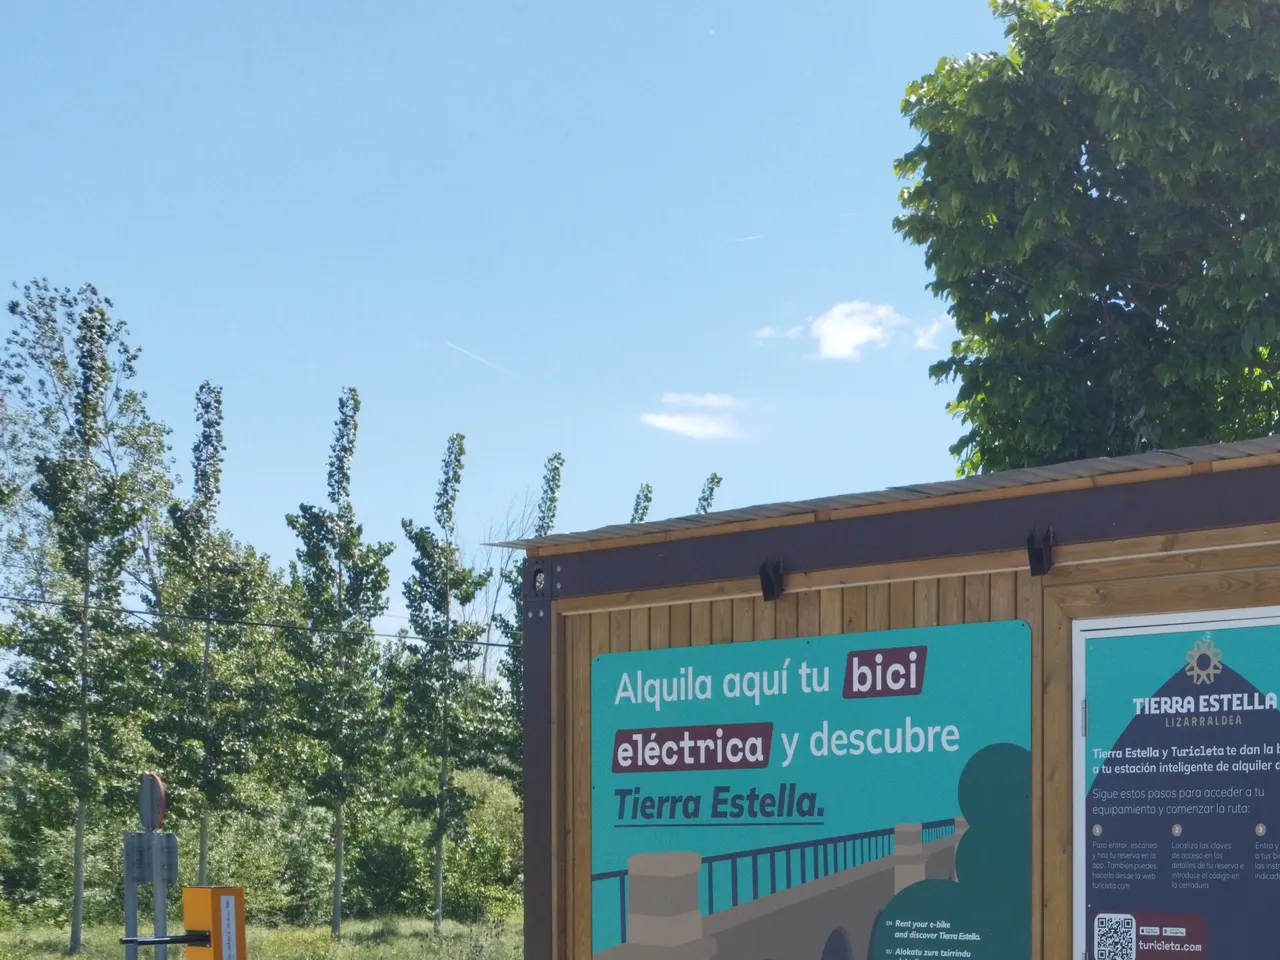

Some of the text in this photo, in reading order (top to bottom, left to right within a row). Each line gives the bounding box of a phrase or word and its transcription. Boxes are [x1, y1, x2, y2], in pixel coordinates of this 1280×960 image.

[614, 651, 917, 711] Alquila aquí tu bici
[1133, 692, 1277, 715] TIERRA ESTELLA
[1165, 715, 1242, 727] LIZARRALDEA
[617, 716, 959, 767] eléctrica y descubre
[1093, 748, 1122, 758] Tierra
[1126, 748, 1159, 758] Estella
[1162, 750, 1168, 759] y
[1171, 746, 1224, 757] Turicleta
[1226, 746, 1237, 755] te
[1239, 744, 1261, 755] dan
[1263, 744, 1274, 754] la
[1093, 765, 1099, 774] a
[1102, 764, 1111, 773] tu
[1114, 761, 1156, 773] estación
[1159, 761, 1213, 774] inteligente
[1216, 761, 1229, 772] de
[1232, 760, 1271, 773] alquiler
[1093, 788, 1265, 801] Sigue estos pasos para acceder a tu
[614, 783, 824, 820] Tierra Estella.
[1093, 804, 1250, 816] equipamiento y comenzar la ruta:
[912, 921, 928, 929] your
[939, 932, 957, 940] Tierra
[895, 948, 922, 956] Alokatu
[1139, 941, 1202, 952] turicleta.com
